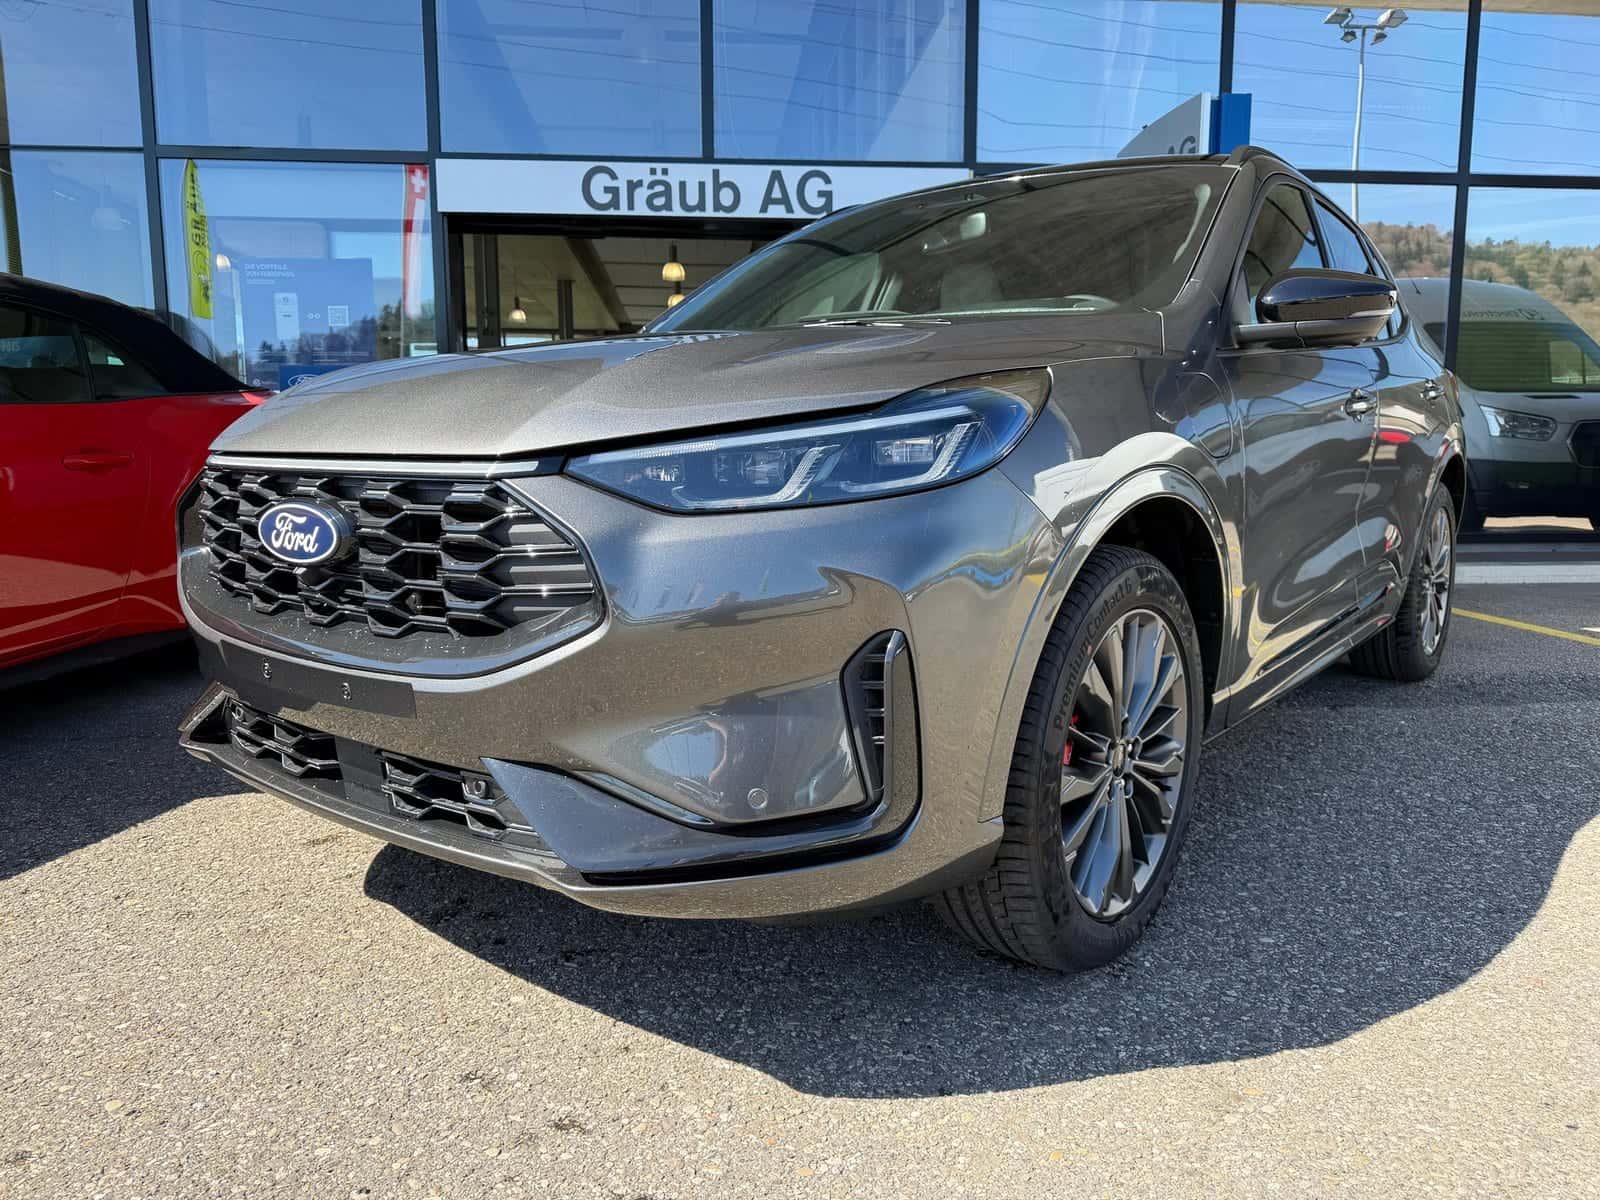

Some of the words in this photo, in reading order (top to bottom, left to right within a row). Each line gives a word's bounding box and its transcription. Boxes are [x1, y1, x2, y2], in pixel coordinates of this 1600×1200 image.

[582, 165, 741, 214] Gräub
[759, 169, 833, 215] AG
[272, 512, 319, 553] Ford
